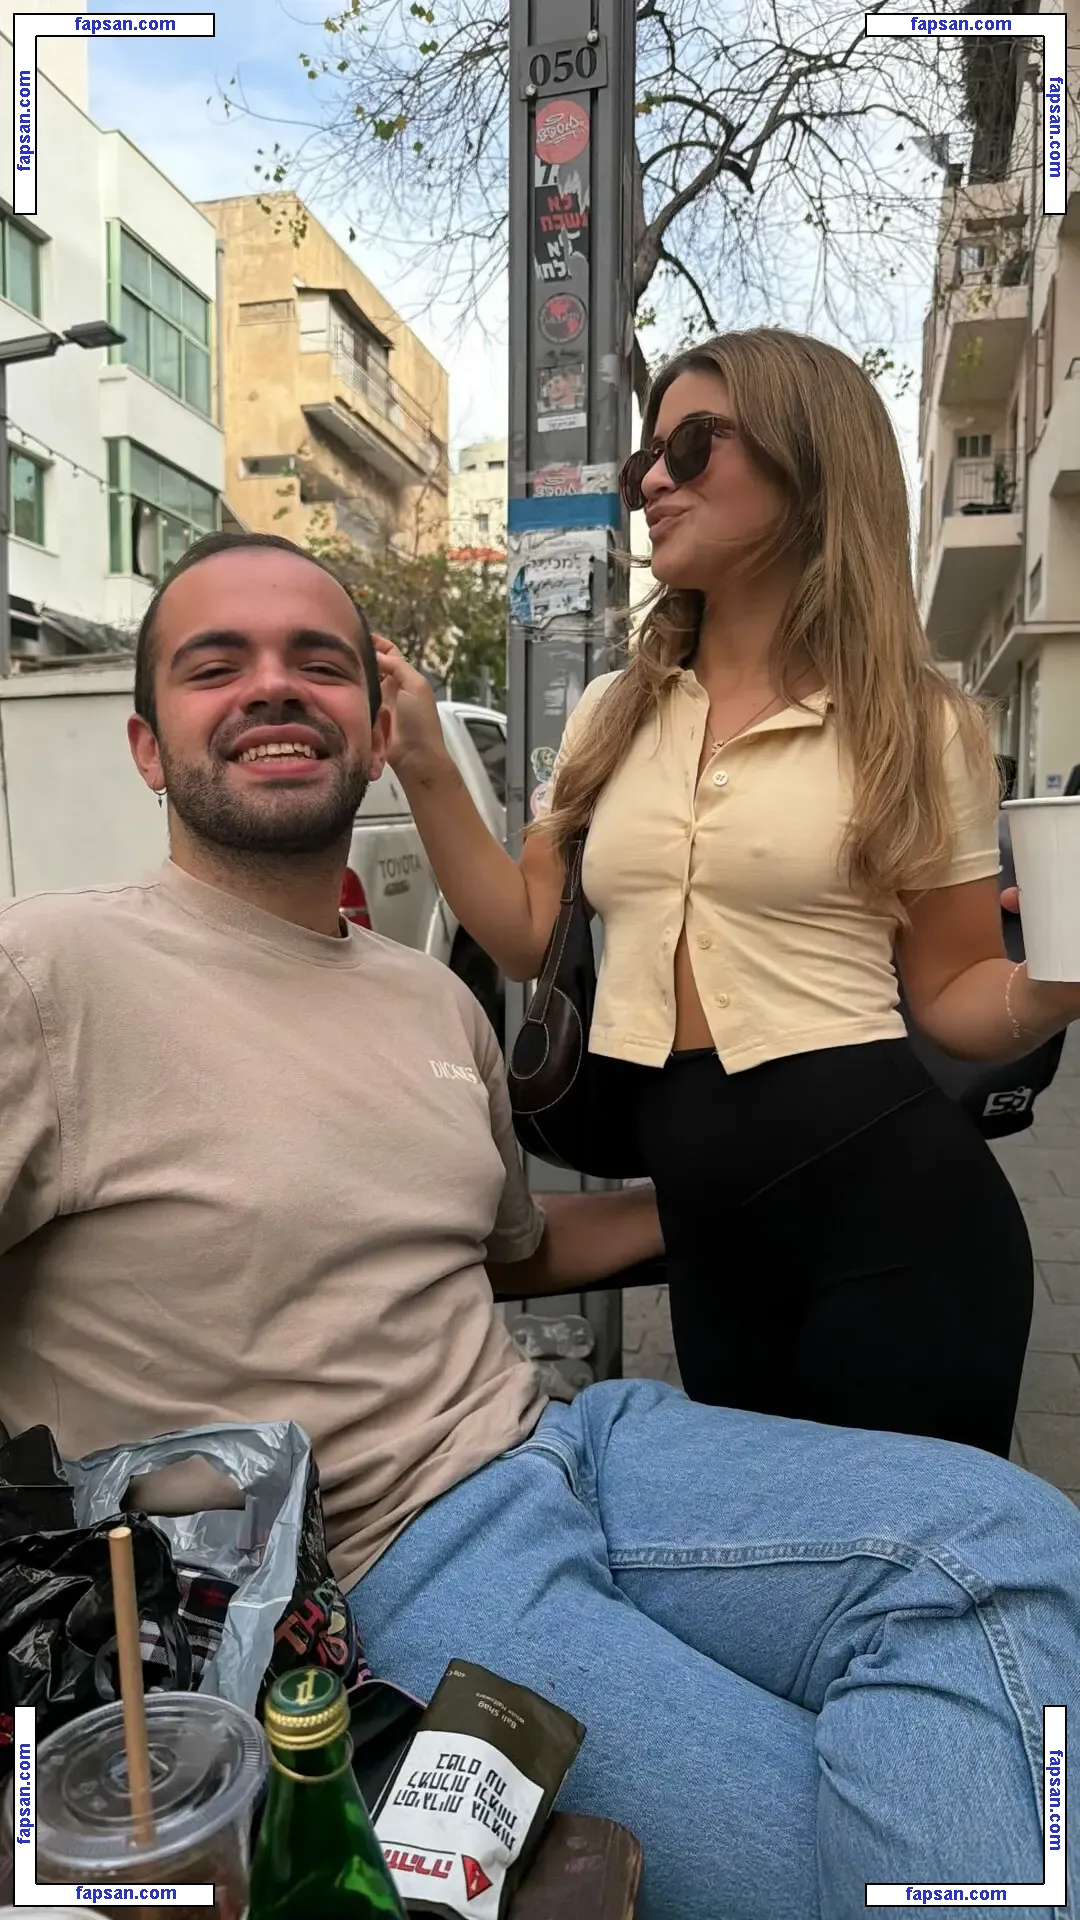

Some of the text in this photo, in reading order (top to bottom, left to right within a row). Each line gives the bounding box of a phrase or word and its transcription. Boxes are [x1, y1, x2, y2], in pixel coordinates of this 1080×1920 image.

[530, 47, 597, 86] 050
[379, 854, 422, 879] TOYOTA
[477, 1700, 518, 1730] Bali Shag
[407, 1771, 470, 1793] למחלות
[435, 1753, 507, 1797] בטרם עת
